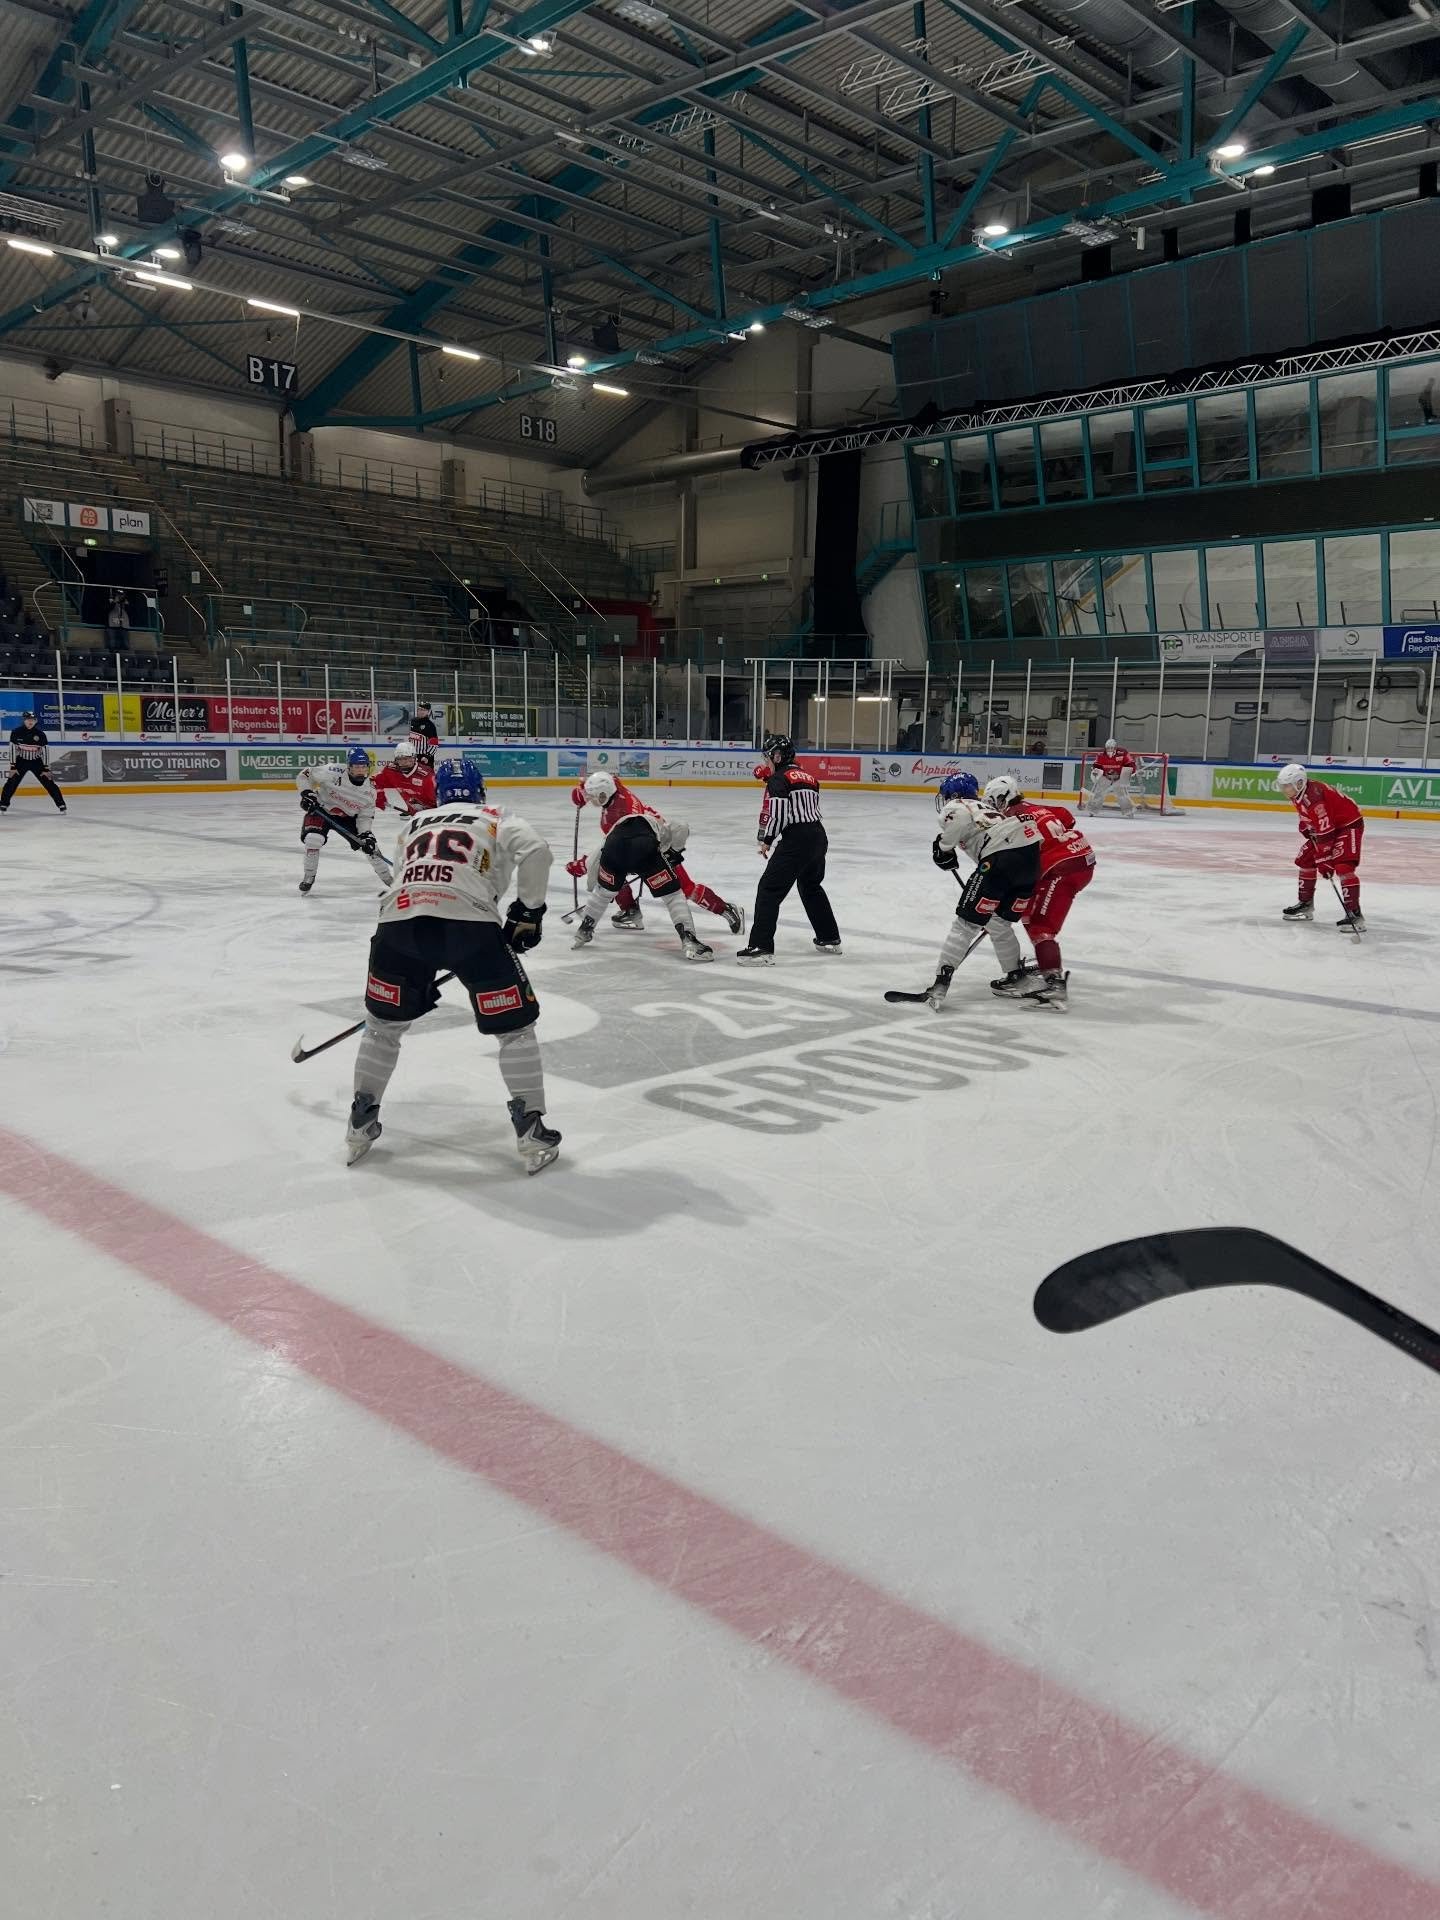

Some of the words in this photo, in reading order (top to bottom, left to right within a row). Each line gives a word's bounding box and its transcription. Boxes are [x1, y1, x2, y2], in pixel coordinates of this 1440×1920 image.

[249, 356, 265, 383] B
[269, 362, 296, 389] 17
[521, 415, 533, 437] B
[536, 419, 556, 442] 18
[119, 514, 144, 529] plan
[1185, 631, 1261, 644] TRANSPORTE
[1408, 635, 1423, 643] das
[287, 707, 302, 716] 110
[124, 758, 164, 769] TUTTO
[167, 758, 221, 769] ITALIANO
[692, 760, 755, 769] FICOTEC
[1215, 776, 1252, 791] WHY
[1387, 778, 1440, 800] AVL
[402, 864, 454, 885] REKIS
[483, 993, 518, 1009] müller
[630, 990, 851, 1040] 29
[643, 1020, 1067, 1135] GROUP
